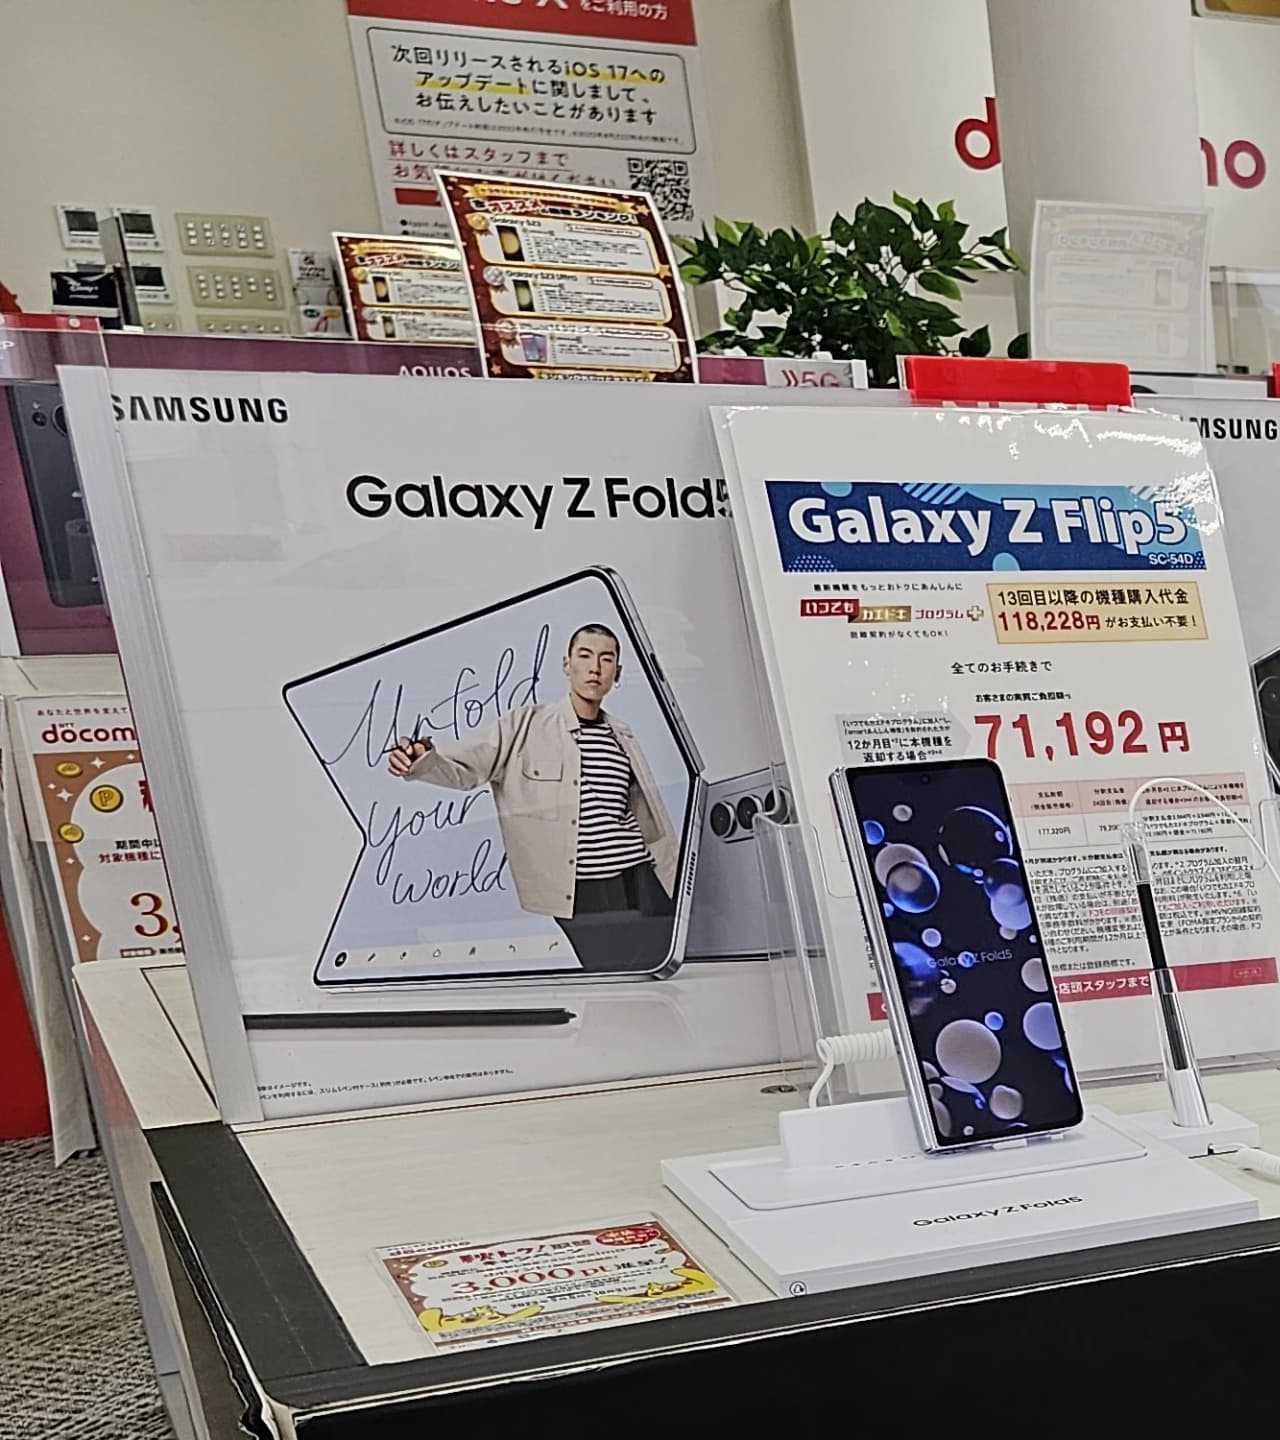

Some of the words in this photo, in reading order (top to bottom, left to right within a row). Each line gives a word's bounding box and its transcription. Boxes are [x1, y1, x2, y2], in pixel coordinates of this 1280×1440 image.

[111, 394, 289, 426] SAMSUNG
[345, 476, 553, 530] Galaxy
[564, 478, 595, 519] Z
[788, 496, 991, 556] Galaxy
[1001, 500, 1043, 544] Z
[1054, 498, 1187, 555] Flip5
[1149, 554, 1194, 566] SC-54D
[805, 601, 854, 615] いつでも
[915, 609, 964, 620] プログラム
[998, 588, 1190, 606] 13回目以降の機種購入代金
[998, 610, 1101, 632] 118,228円
[951, 660, 1052, 675] 全てのお手続きで
[1159, 720, 1190, 753] 円
[392, 839, 509, 906] world
[913, 1209, 999, 1227] Galaxy
[1021, 1196, 1084, 1211] Fold5
